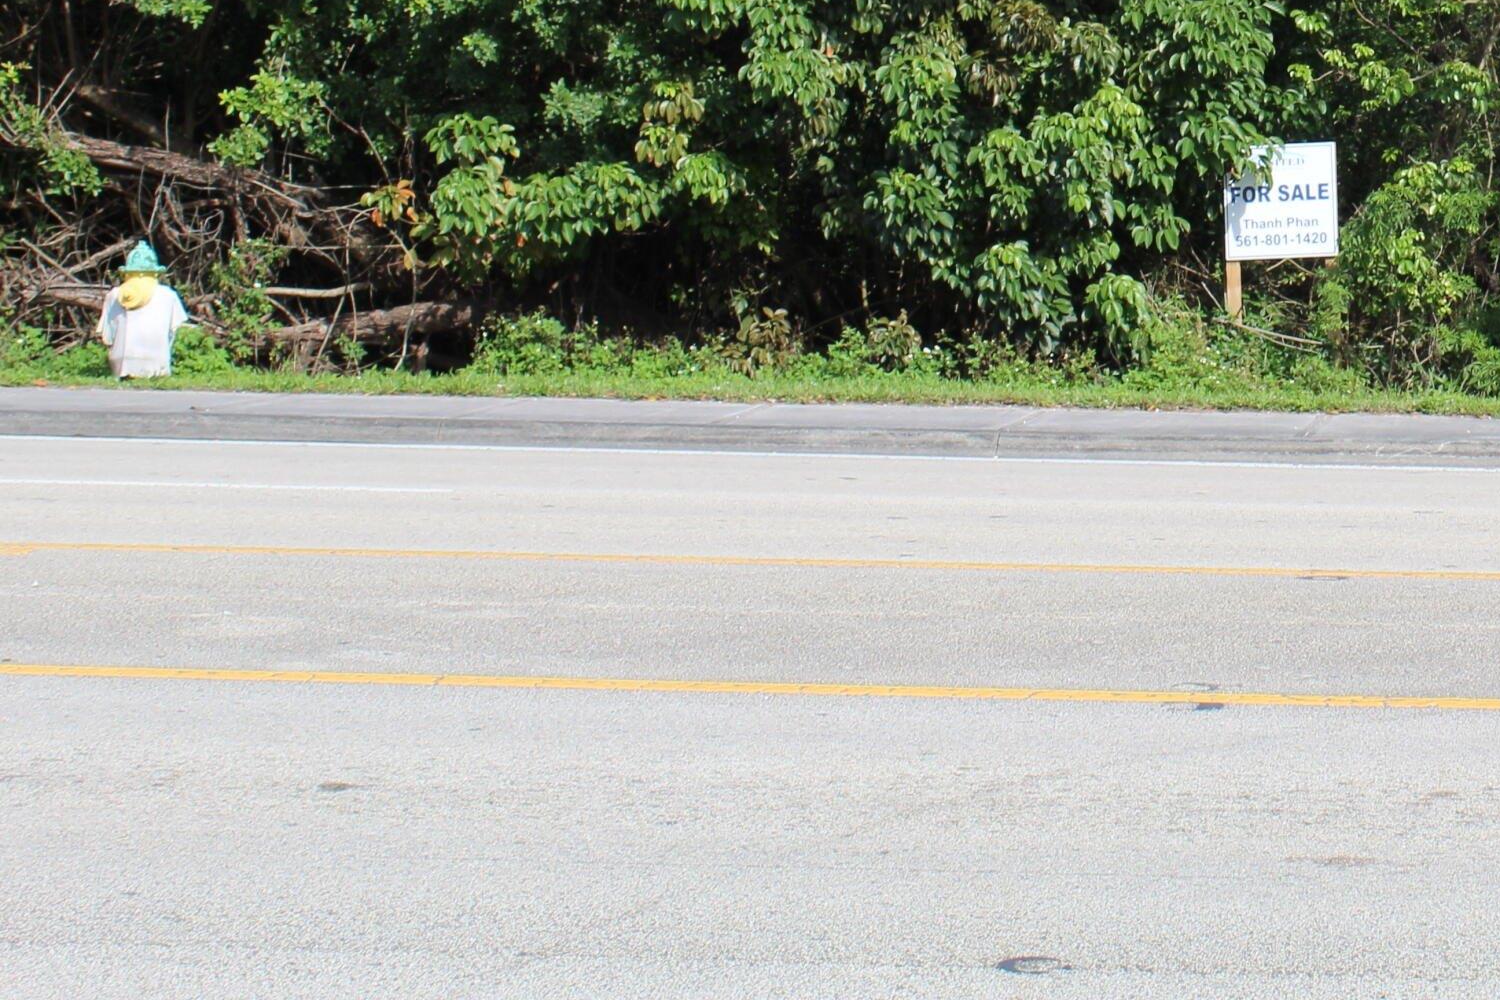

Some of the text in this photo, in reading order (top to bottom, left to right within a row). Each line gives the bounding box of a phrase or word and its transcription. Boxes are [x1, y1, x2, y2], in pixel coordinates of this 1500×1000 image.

[1230, 183, 1329, 203] FOR SALE
[1243, 217, 1319, 230] Thanh Phan
[1235, 231, 1328, 248] 561-801-1420
